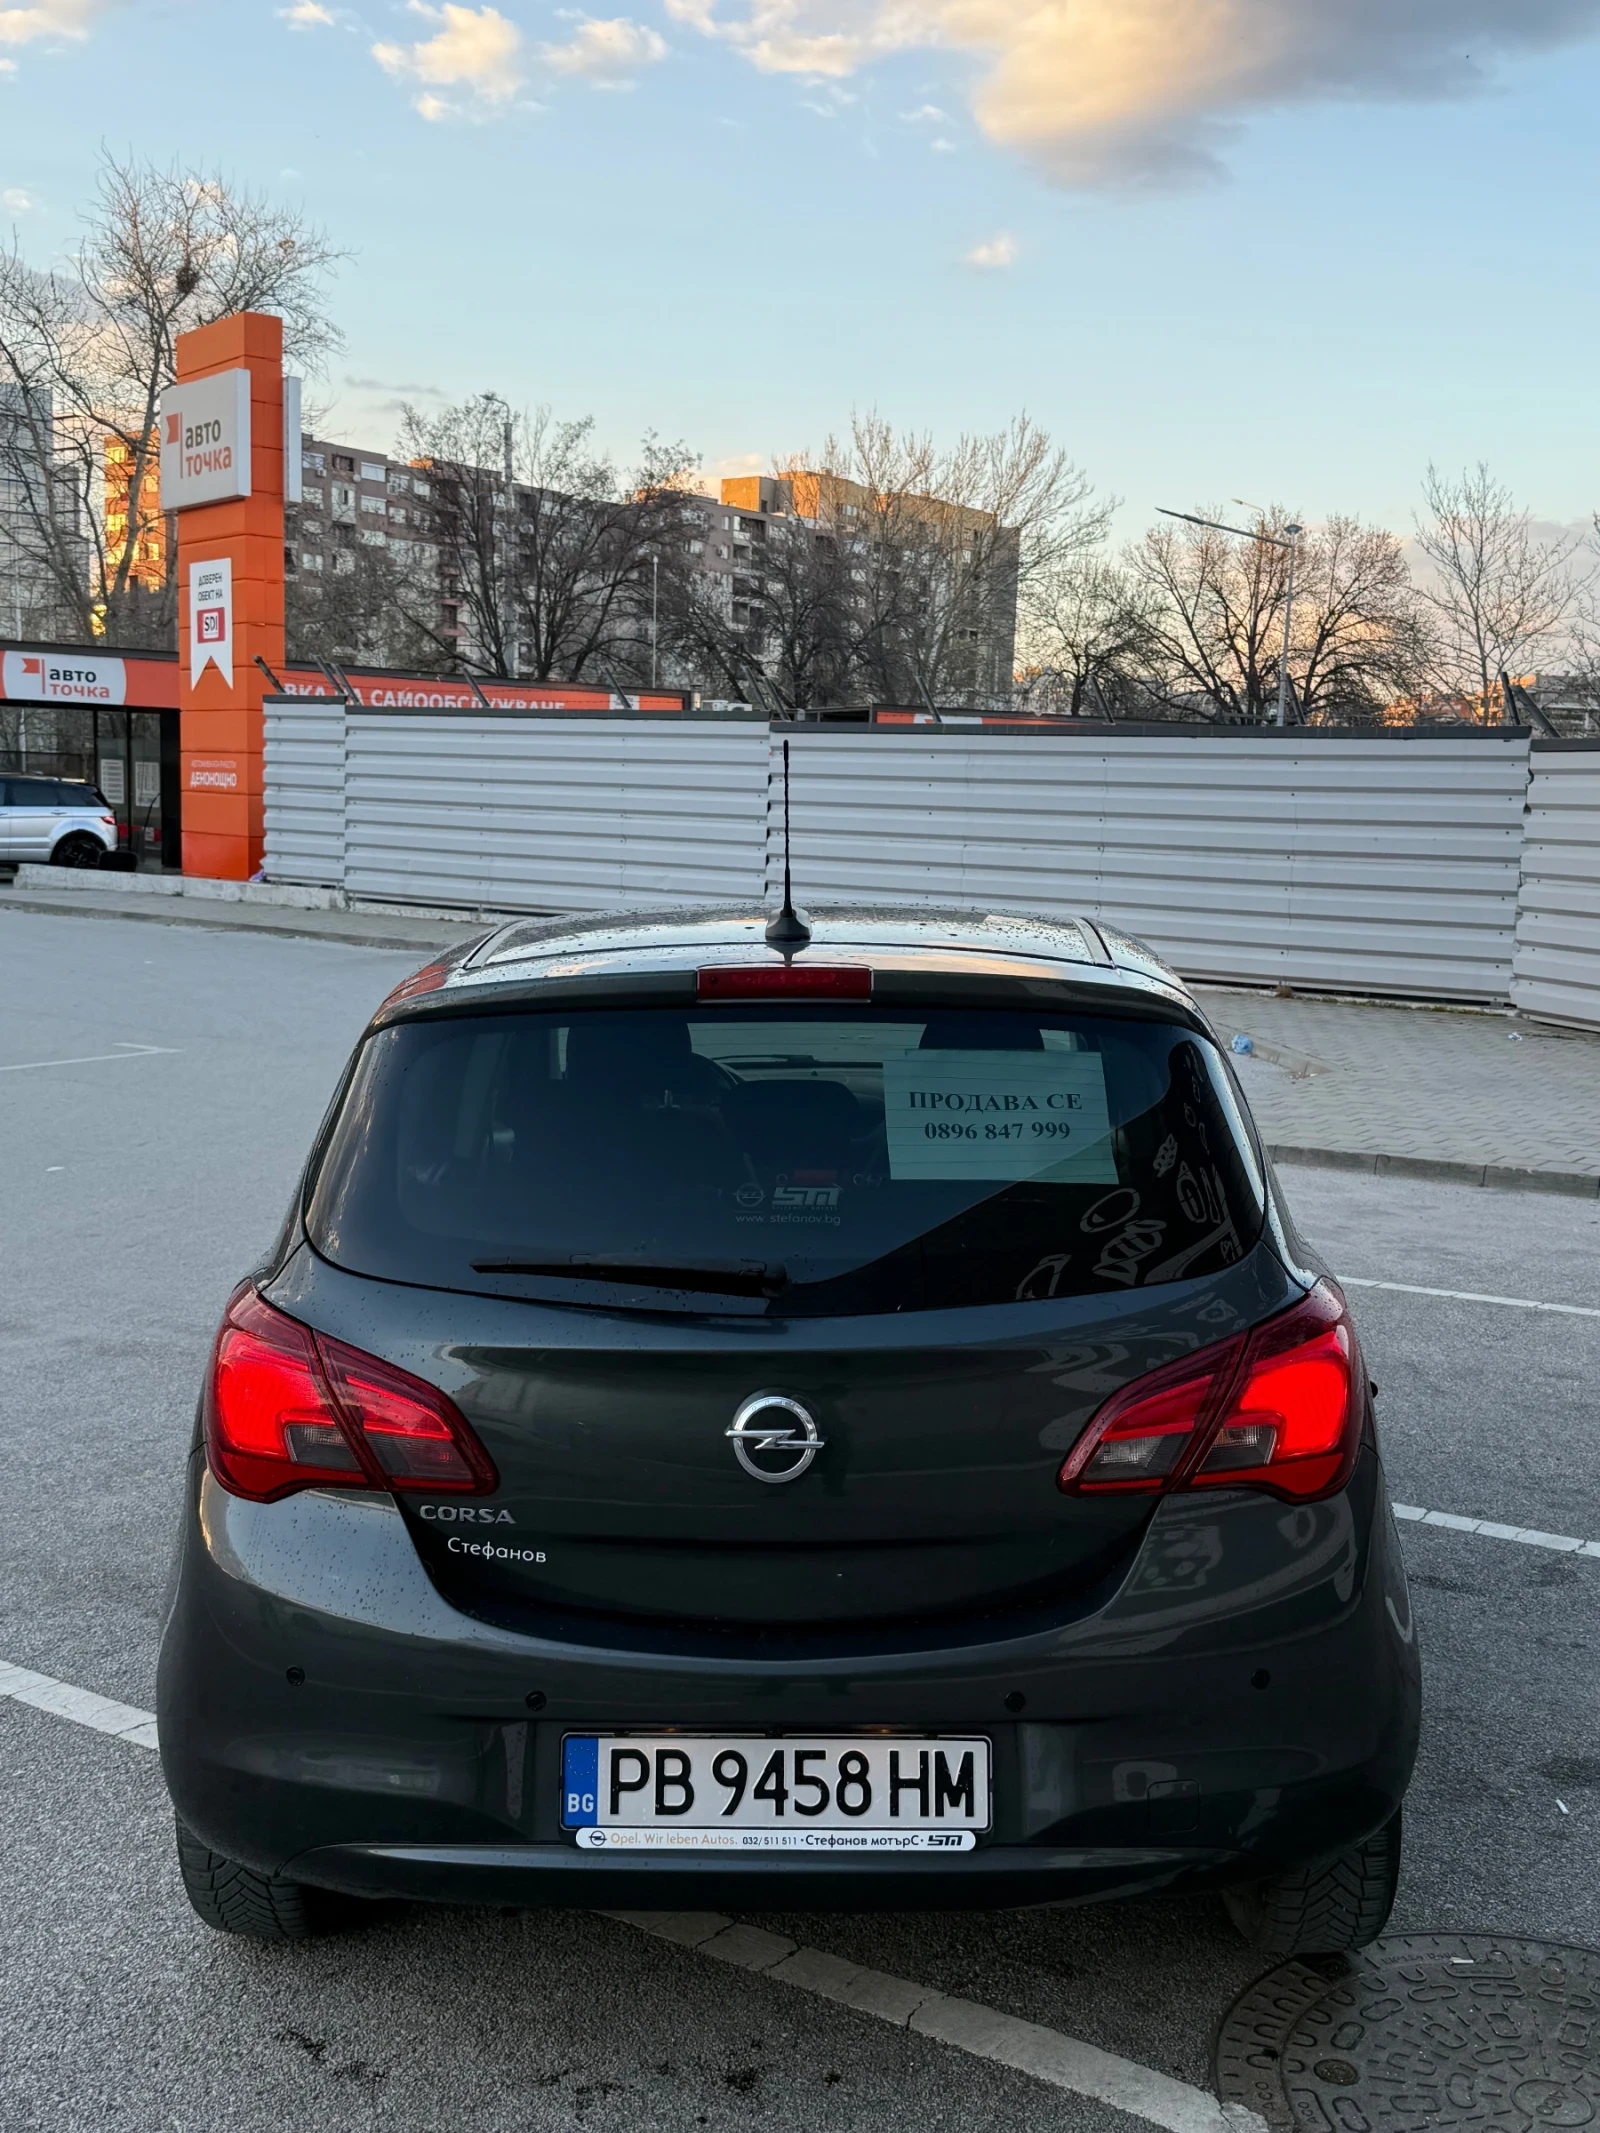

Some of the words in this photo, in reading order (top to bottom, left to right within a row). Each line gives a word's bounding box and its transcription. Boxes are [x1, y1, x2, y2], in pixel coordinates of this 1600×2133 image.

[185, 419, 221, 449] авто
[185, 446, 232, 477] точка
[204, 615, 219, 632] SDI
[49, 668, 97, 683] авто
[49, 683, 111, 699] точка
[189, 771, 238, 789] ДЕНОНОЩНО
[909, 1091, 1040, 1114] ПРОДАВА
[1046, 1093, 1083, 1110] СЕ
[924, 1122, 978, 1139] 0896
[984, 1122, 1024, 1139] 847
[1031, 1121, 1071, 1139] 999
[420, 1505, 517, 1524] CORSA
[447, 1537, 547, 1563] Стефанов
[609, 1748, 695, 1816] PB
[711, 1748, 872, 1817] 9458
[889, 1749, 975, 1818] HM
[567, 1793, 594, 1812] BG
[610, 1832, 641, 1846] Opel.
[644, 1832, 663, 1844] Wir
[666, 1833, 698, 1845] leben
[701, 1834, 738, 1846] Autos.
[781, 1836, 797, 1845] 511
